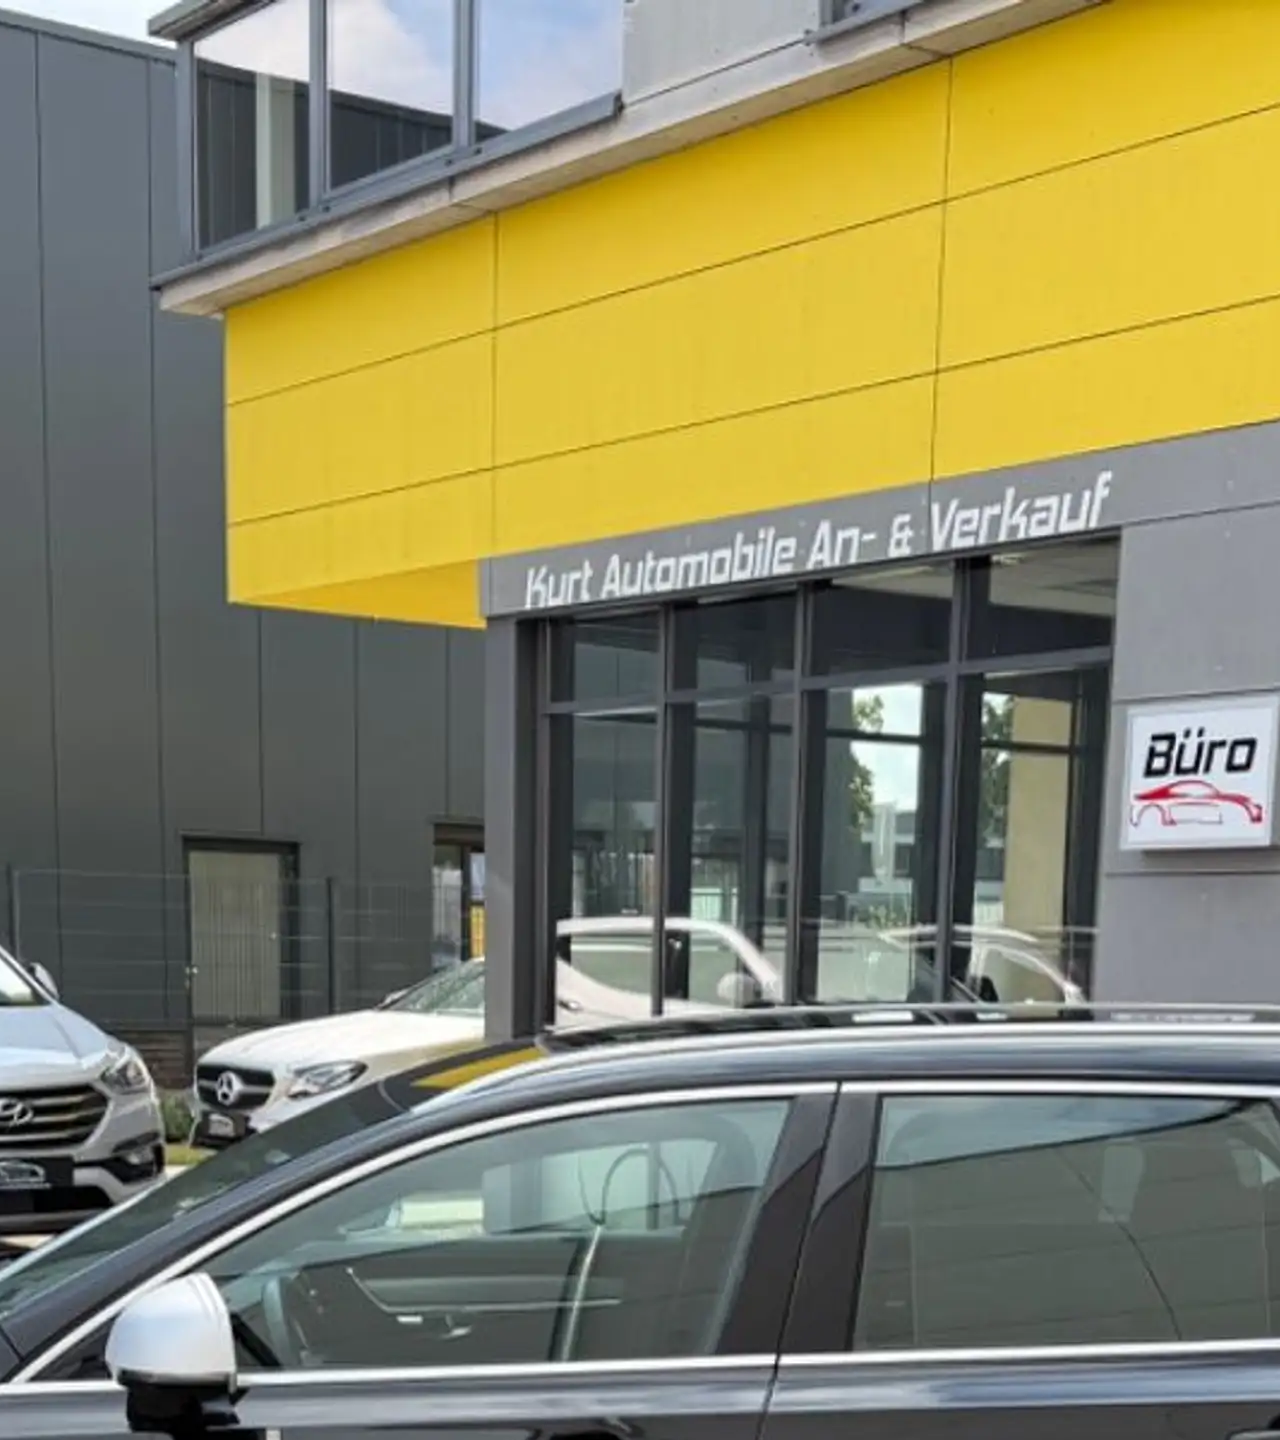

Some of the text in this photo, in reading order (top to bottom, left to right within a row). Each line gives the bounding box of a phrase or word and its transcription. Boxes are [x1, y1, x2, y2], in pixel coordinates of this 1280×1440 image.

[524, 470, 1113, 610] Kurt Automobile An- & Verkauf
[1143, 726, 1258, 779] Büro
